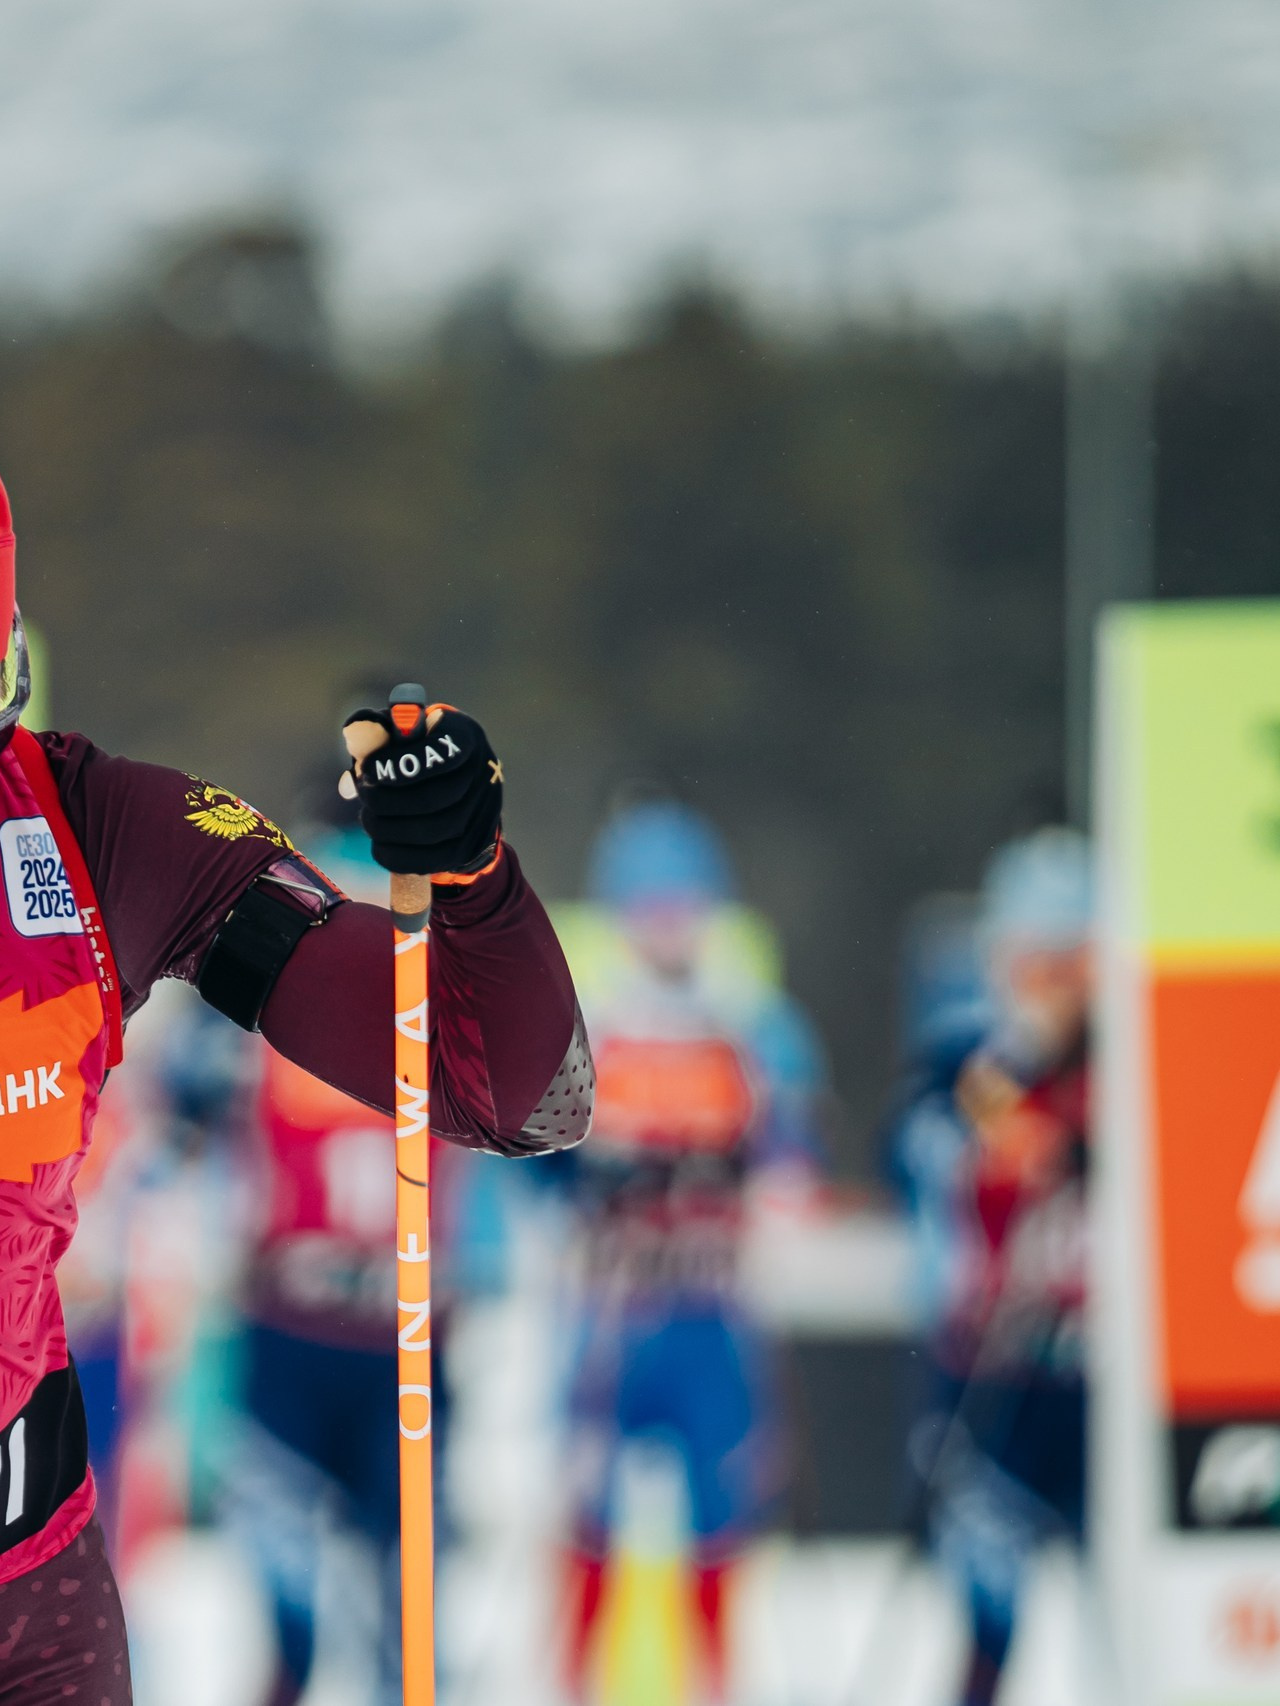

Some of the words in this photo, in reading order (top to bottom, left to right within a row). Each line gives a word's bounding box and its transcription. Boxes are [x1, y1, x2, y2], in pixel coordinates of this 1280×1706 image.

[375, 734, 462, 781] MOAX
[16, 832, 55, 858] СЕЗО
[20, 857, 71, 889] 2024
[23, 888, 77, 920] 2025
